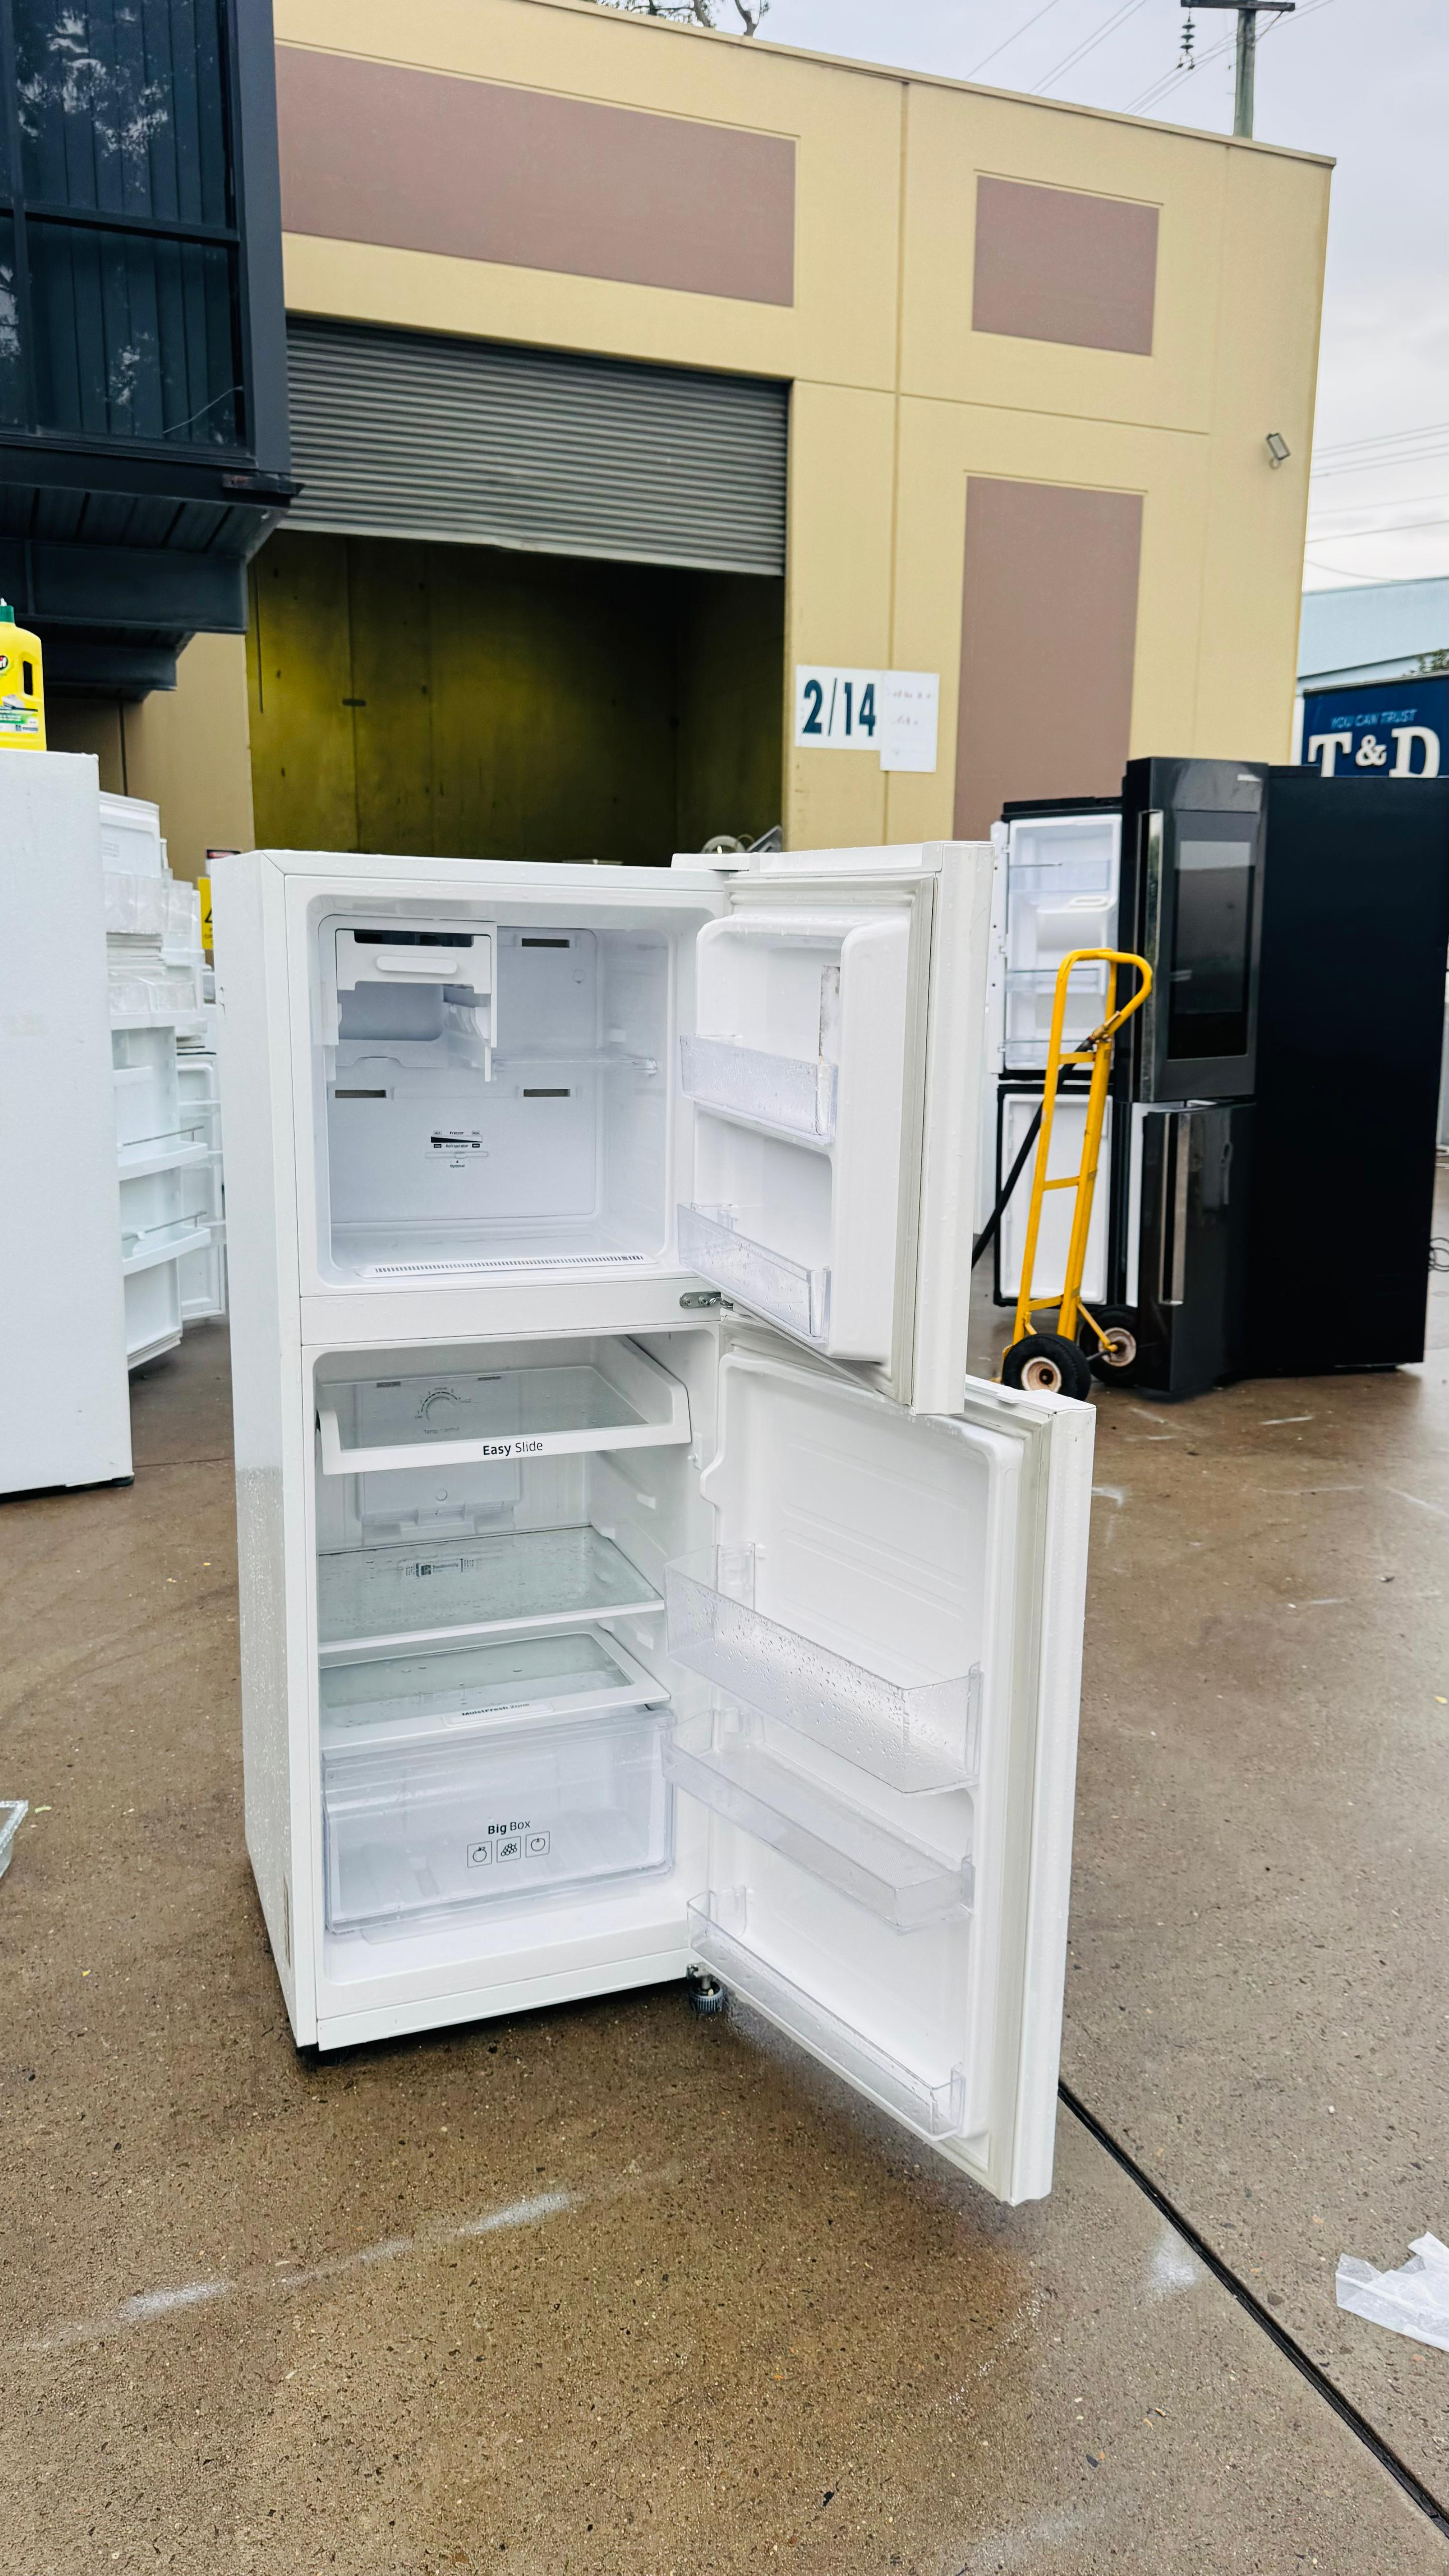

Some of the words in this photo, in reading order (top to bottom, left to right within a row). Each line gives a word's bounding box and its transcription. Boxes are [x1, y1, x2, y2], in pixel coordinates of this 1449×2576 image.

[802, 678, 876, 736] 2/14
[1332, 716, 1354, 729] YOU
[1355, 713, 1379, 726] CAN
[1380, 709, 1417, 724] TRUST
[483, 1445, 511, 1457] Easy
[515, 1441, 543, 1453] Slide
[488, 1824, 507, 1835] Big
[510, 1821, 530, 1831] Box
